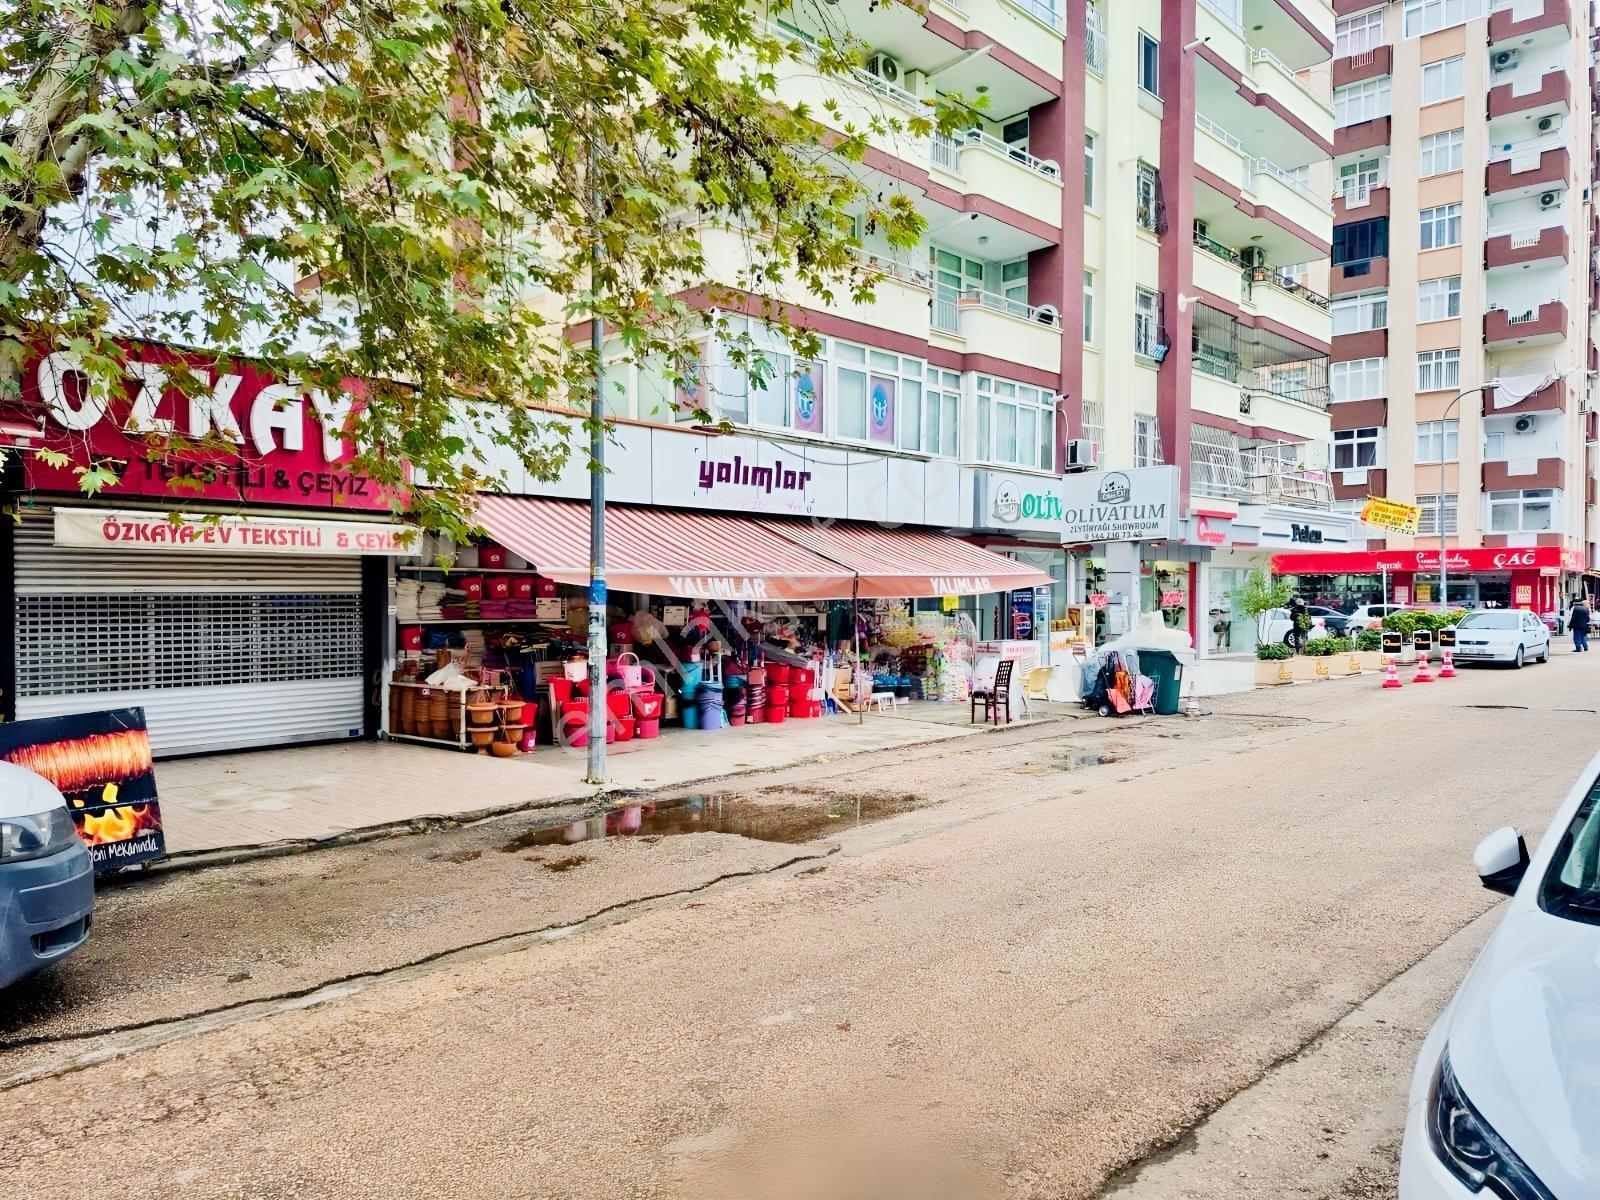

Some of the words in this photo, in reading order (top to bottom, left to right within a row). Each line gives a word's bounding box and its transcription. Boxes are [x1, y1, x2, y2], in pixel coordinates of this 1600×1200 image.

[273, 468, 291, 489] &
[297, 471, 369, 497] ÇEYİZ
[698, 455, 812, 494] yalımlar
[1065, 503, 1166, 524] OLİVATUM
[102, 515, 195, 544] ÖZKAYA
[203, 527, 232, 544] EV
[238, 526, 322, 547] TEKSTİLİ
[336, 532, 349, 547] &
[1112, 522, 1159, 531] SHOWROOM
[1493, 550, 1536, 569] ÇAĞ
[668, 577, 768, 599] YALIMLAR
